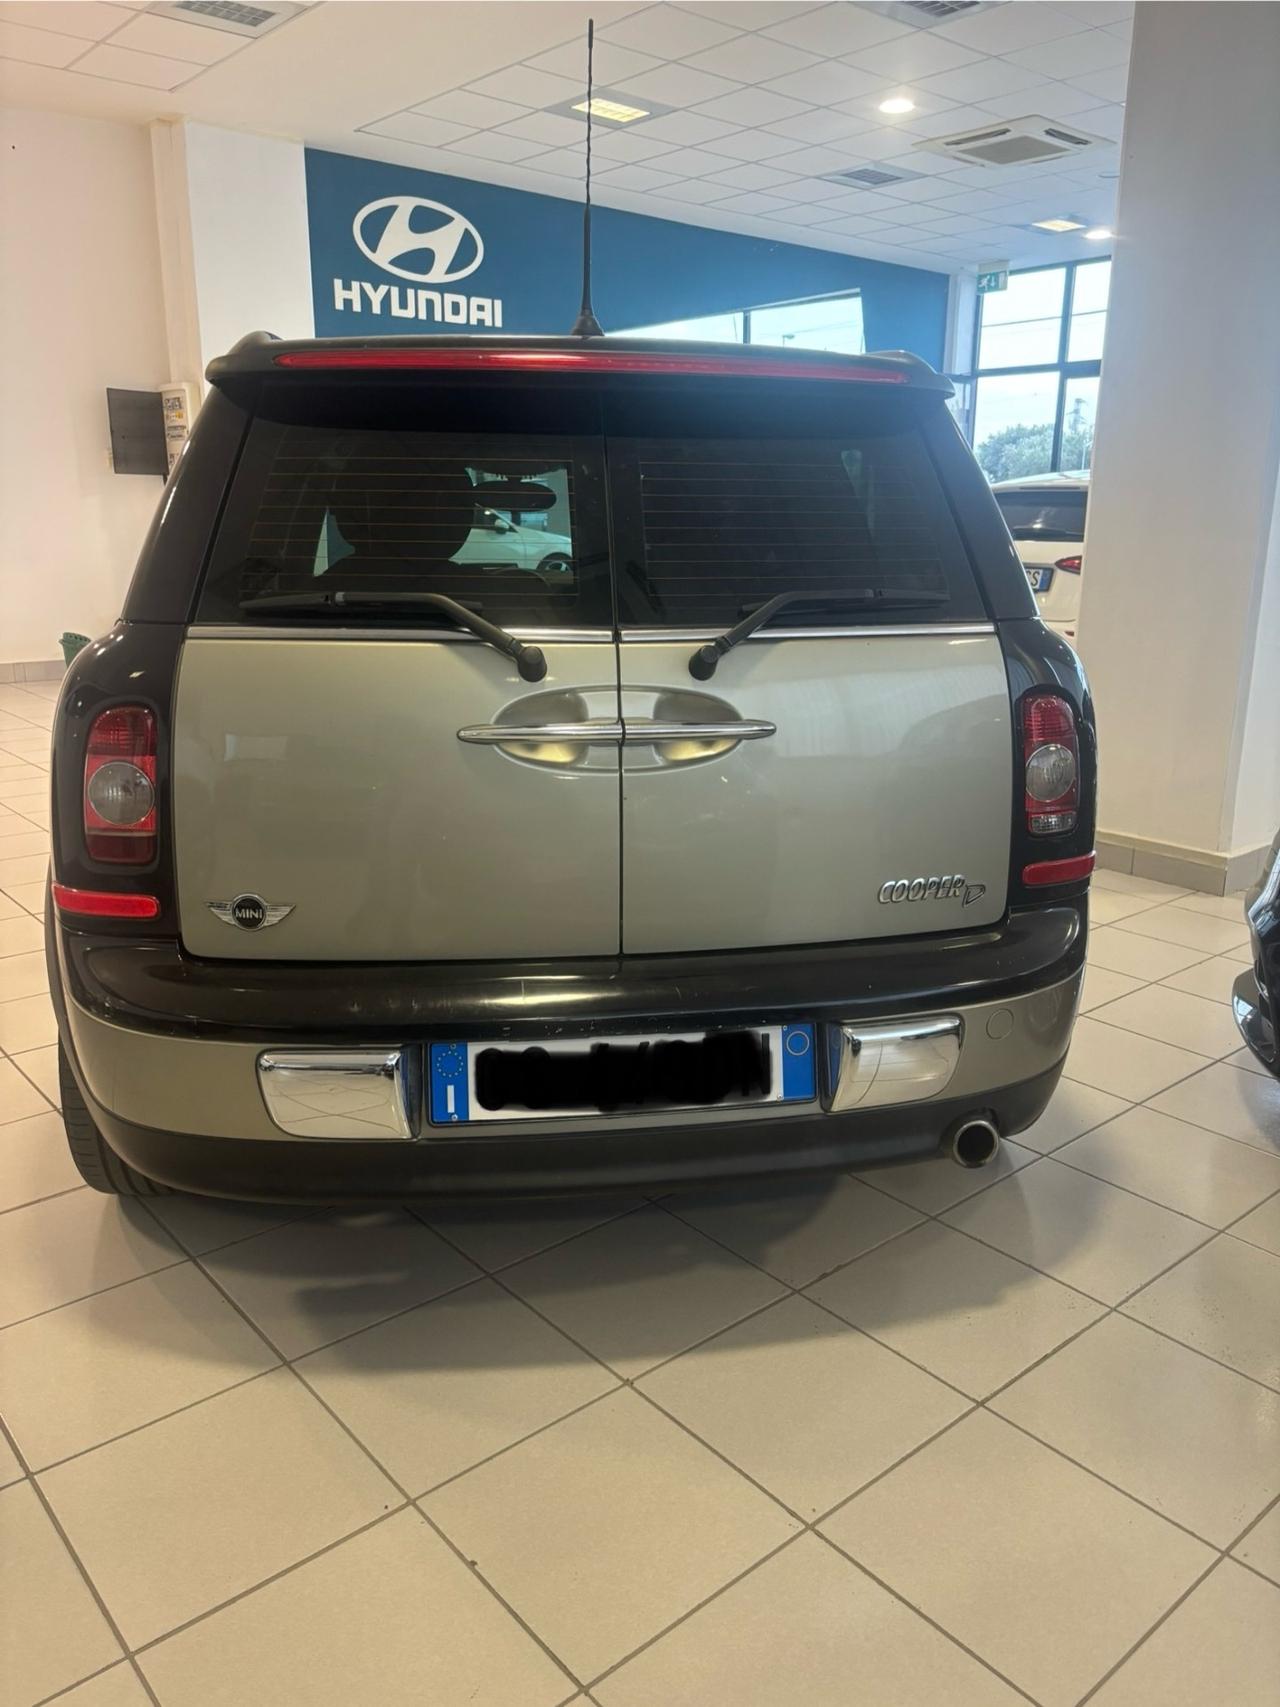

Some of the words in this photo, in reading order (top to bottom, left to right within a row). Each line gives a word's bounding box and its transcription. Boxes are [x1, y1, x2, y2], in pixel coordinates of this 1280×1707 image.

[333, 278, 503, 328] HYUNDAI
[878, 874, 965, 904] COOPER
[235, 908, 263, 919] MINI
